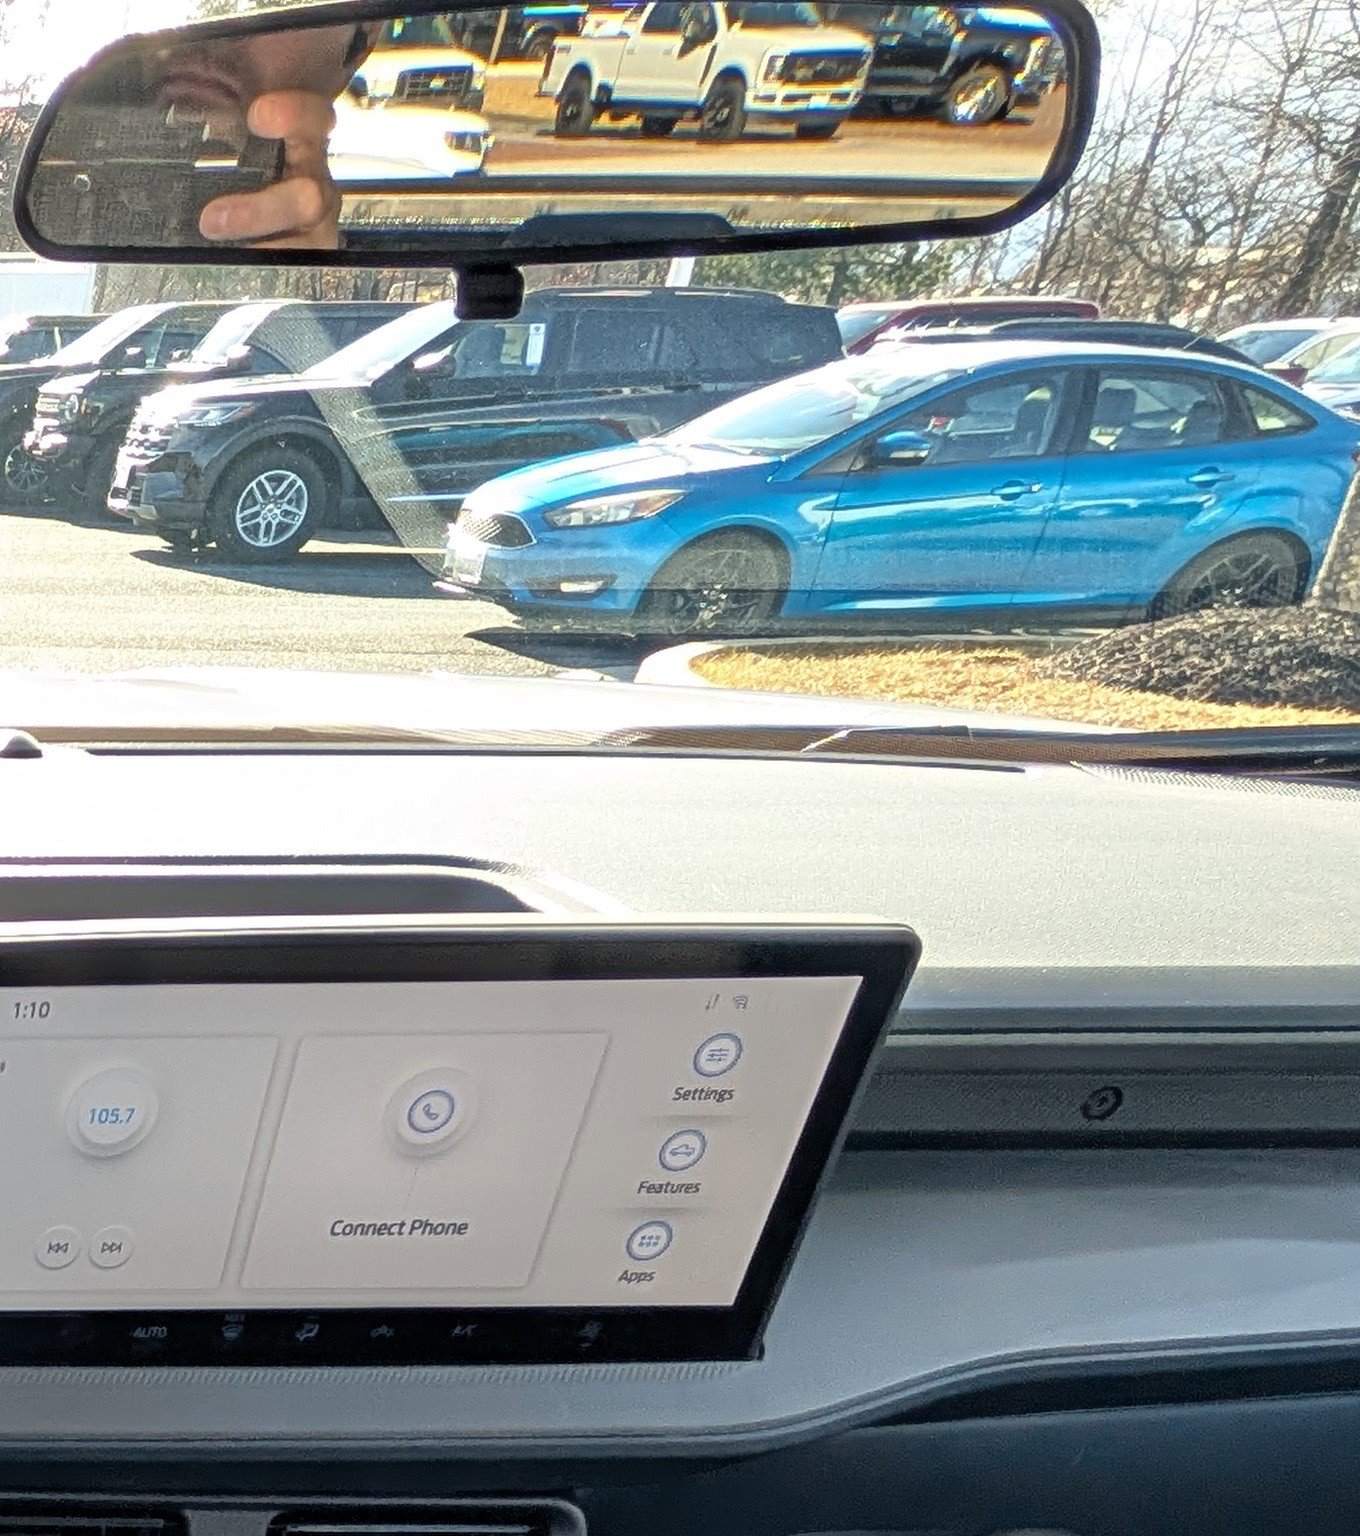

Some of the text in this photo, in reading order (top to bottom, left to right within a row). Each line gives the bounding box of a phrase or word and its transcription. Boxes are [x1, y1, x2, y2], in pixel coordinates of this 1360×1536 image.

[13, 1000, 52, 1019] 1:10
[671, 1085, 736, 1103] Settings
[88, 1107, 136, 1125] 105.7
[636, 1179, 701, 1195] Features
[329, 1217, 469, 1237] Connect Phone
[617, 1268, 656, 1285] Apps
[132, 1324, 170, 1339] AUTO
